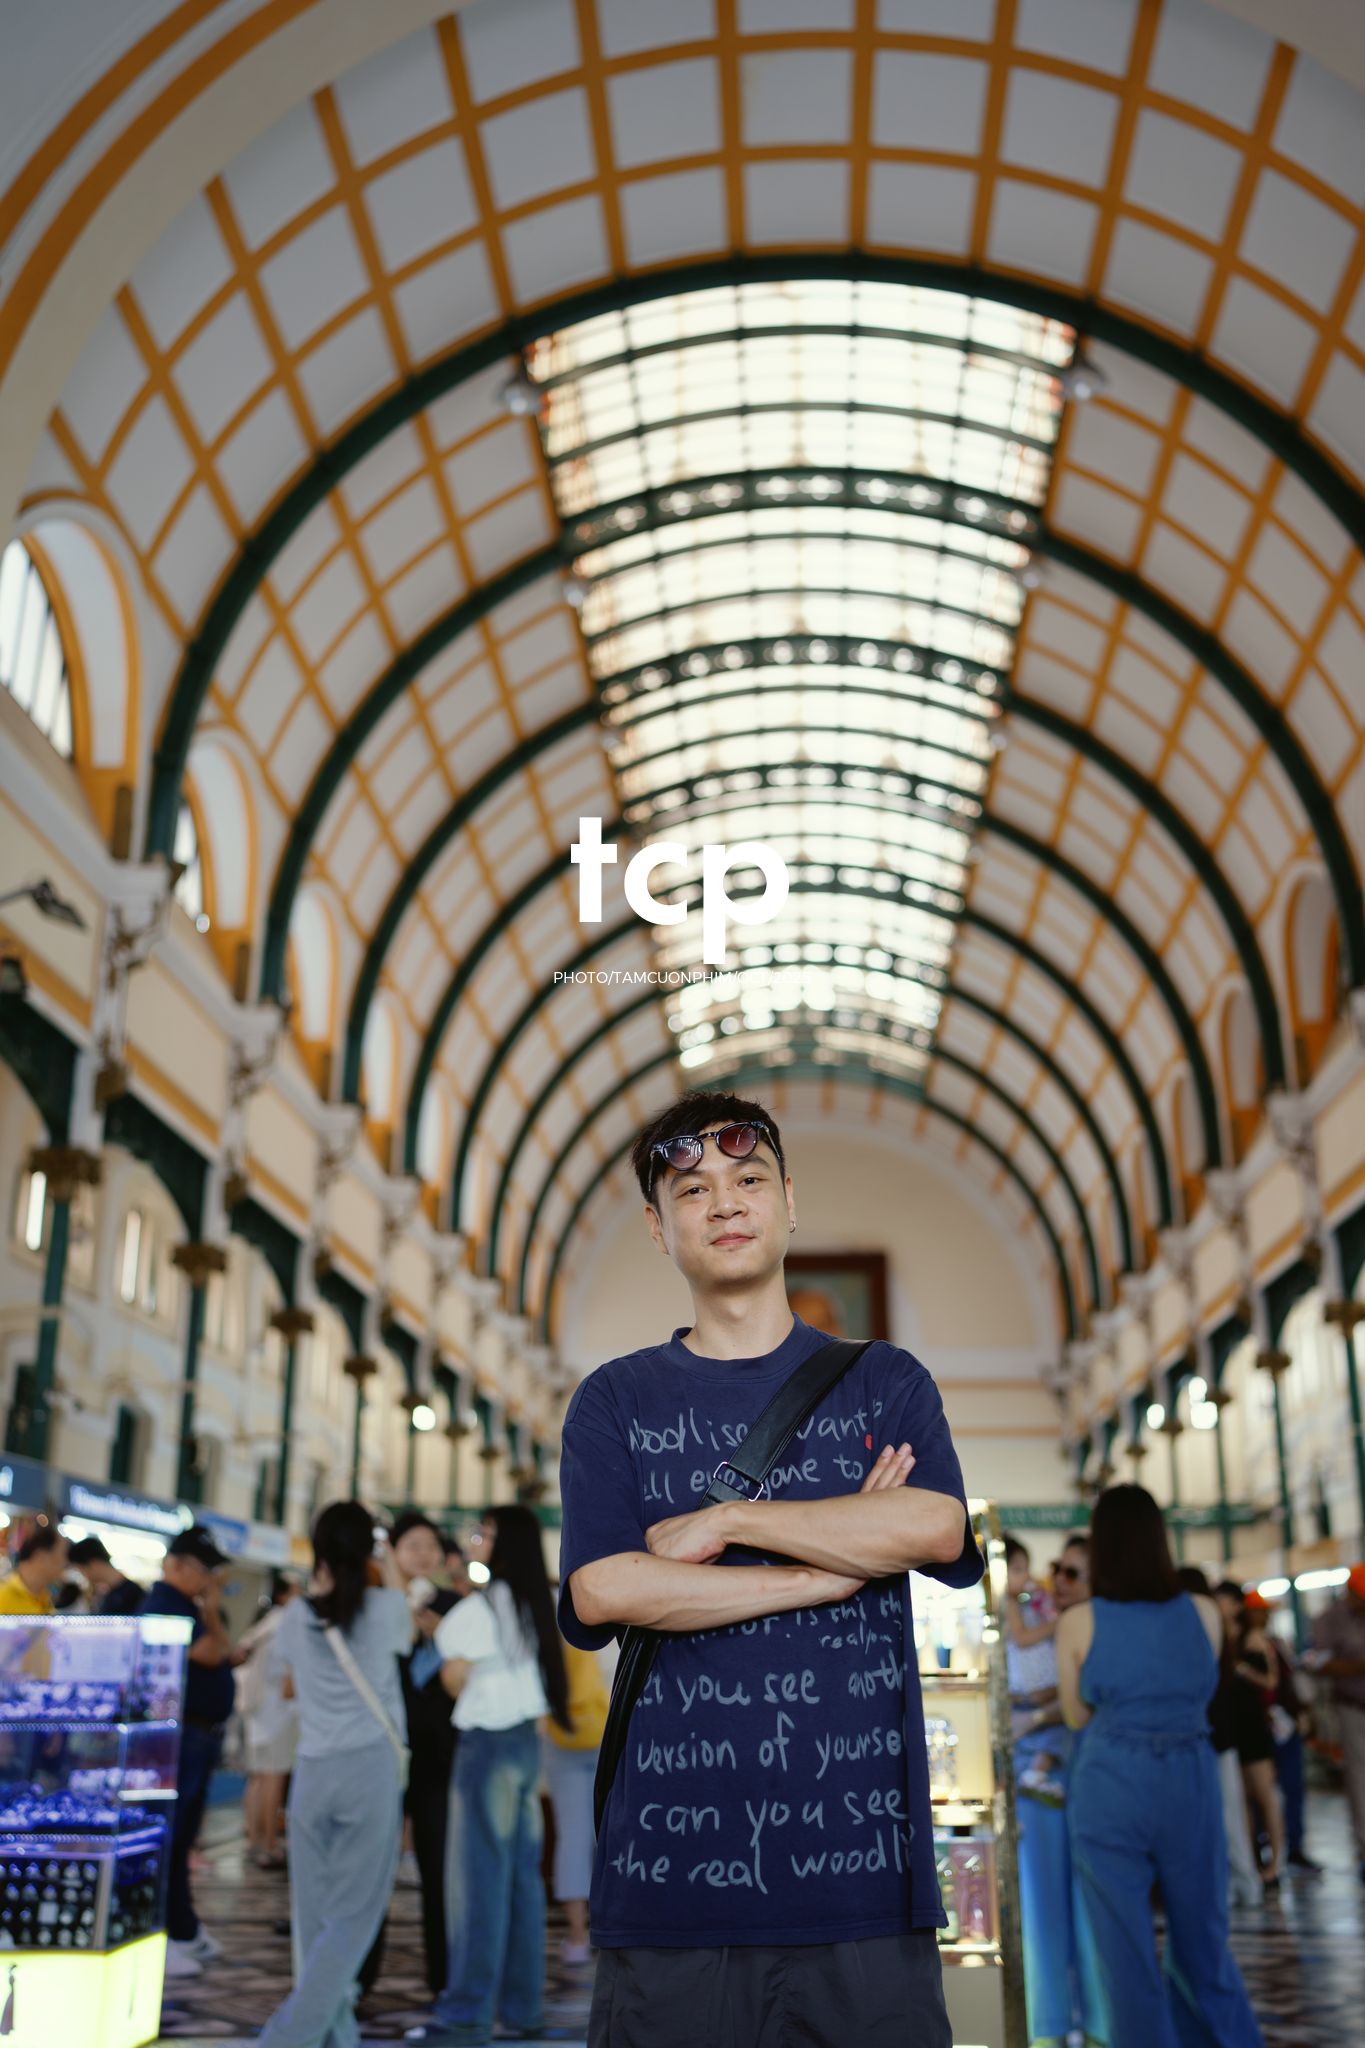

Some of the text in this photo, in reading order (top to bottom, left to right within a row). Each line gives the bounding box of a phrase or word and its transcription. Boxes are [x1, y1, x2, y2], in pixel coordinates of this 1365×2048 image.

[832, 1453, 864, 1481] to
[675, 1673, 752, 1715] you
[763, 1668, 821, 1705] see
[637, 1731, 737, 1776] version
[758, 1710, 796, 1773] of
[639, 1787, 909, 1848] can you see
[609, 1839, 671, 1885] the
[687, 1839, 769, 1895] real
